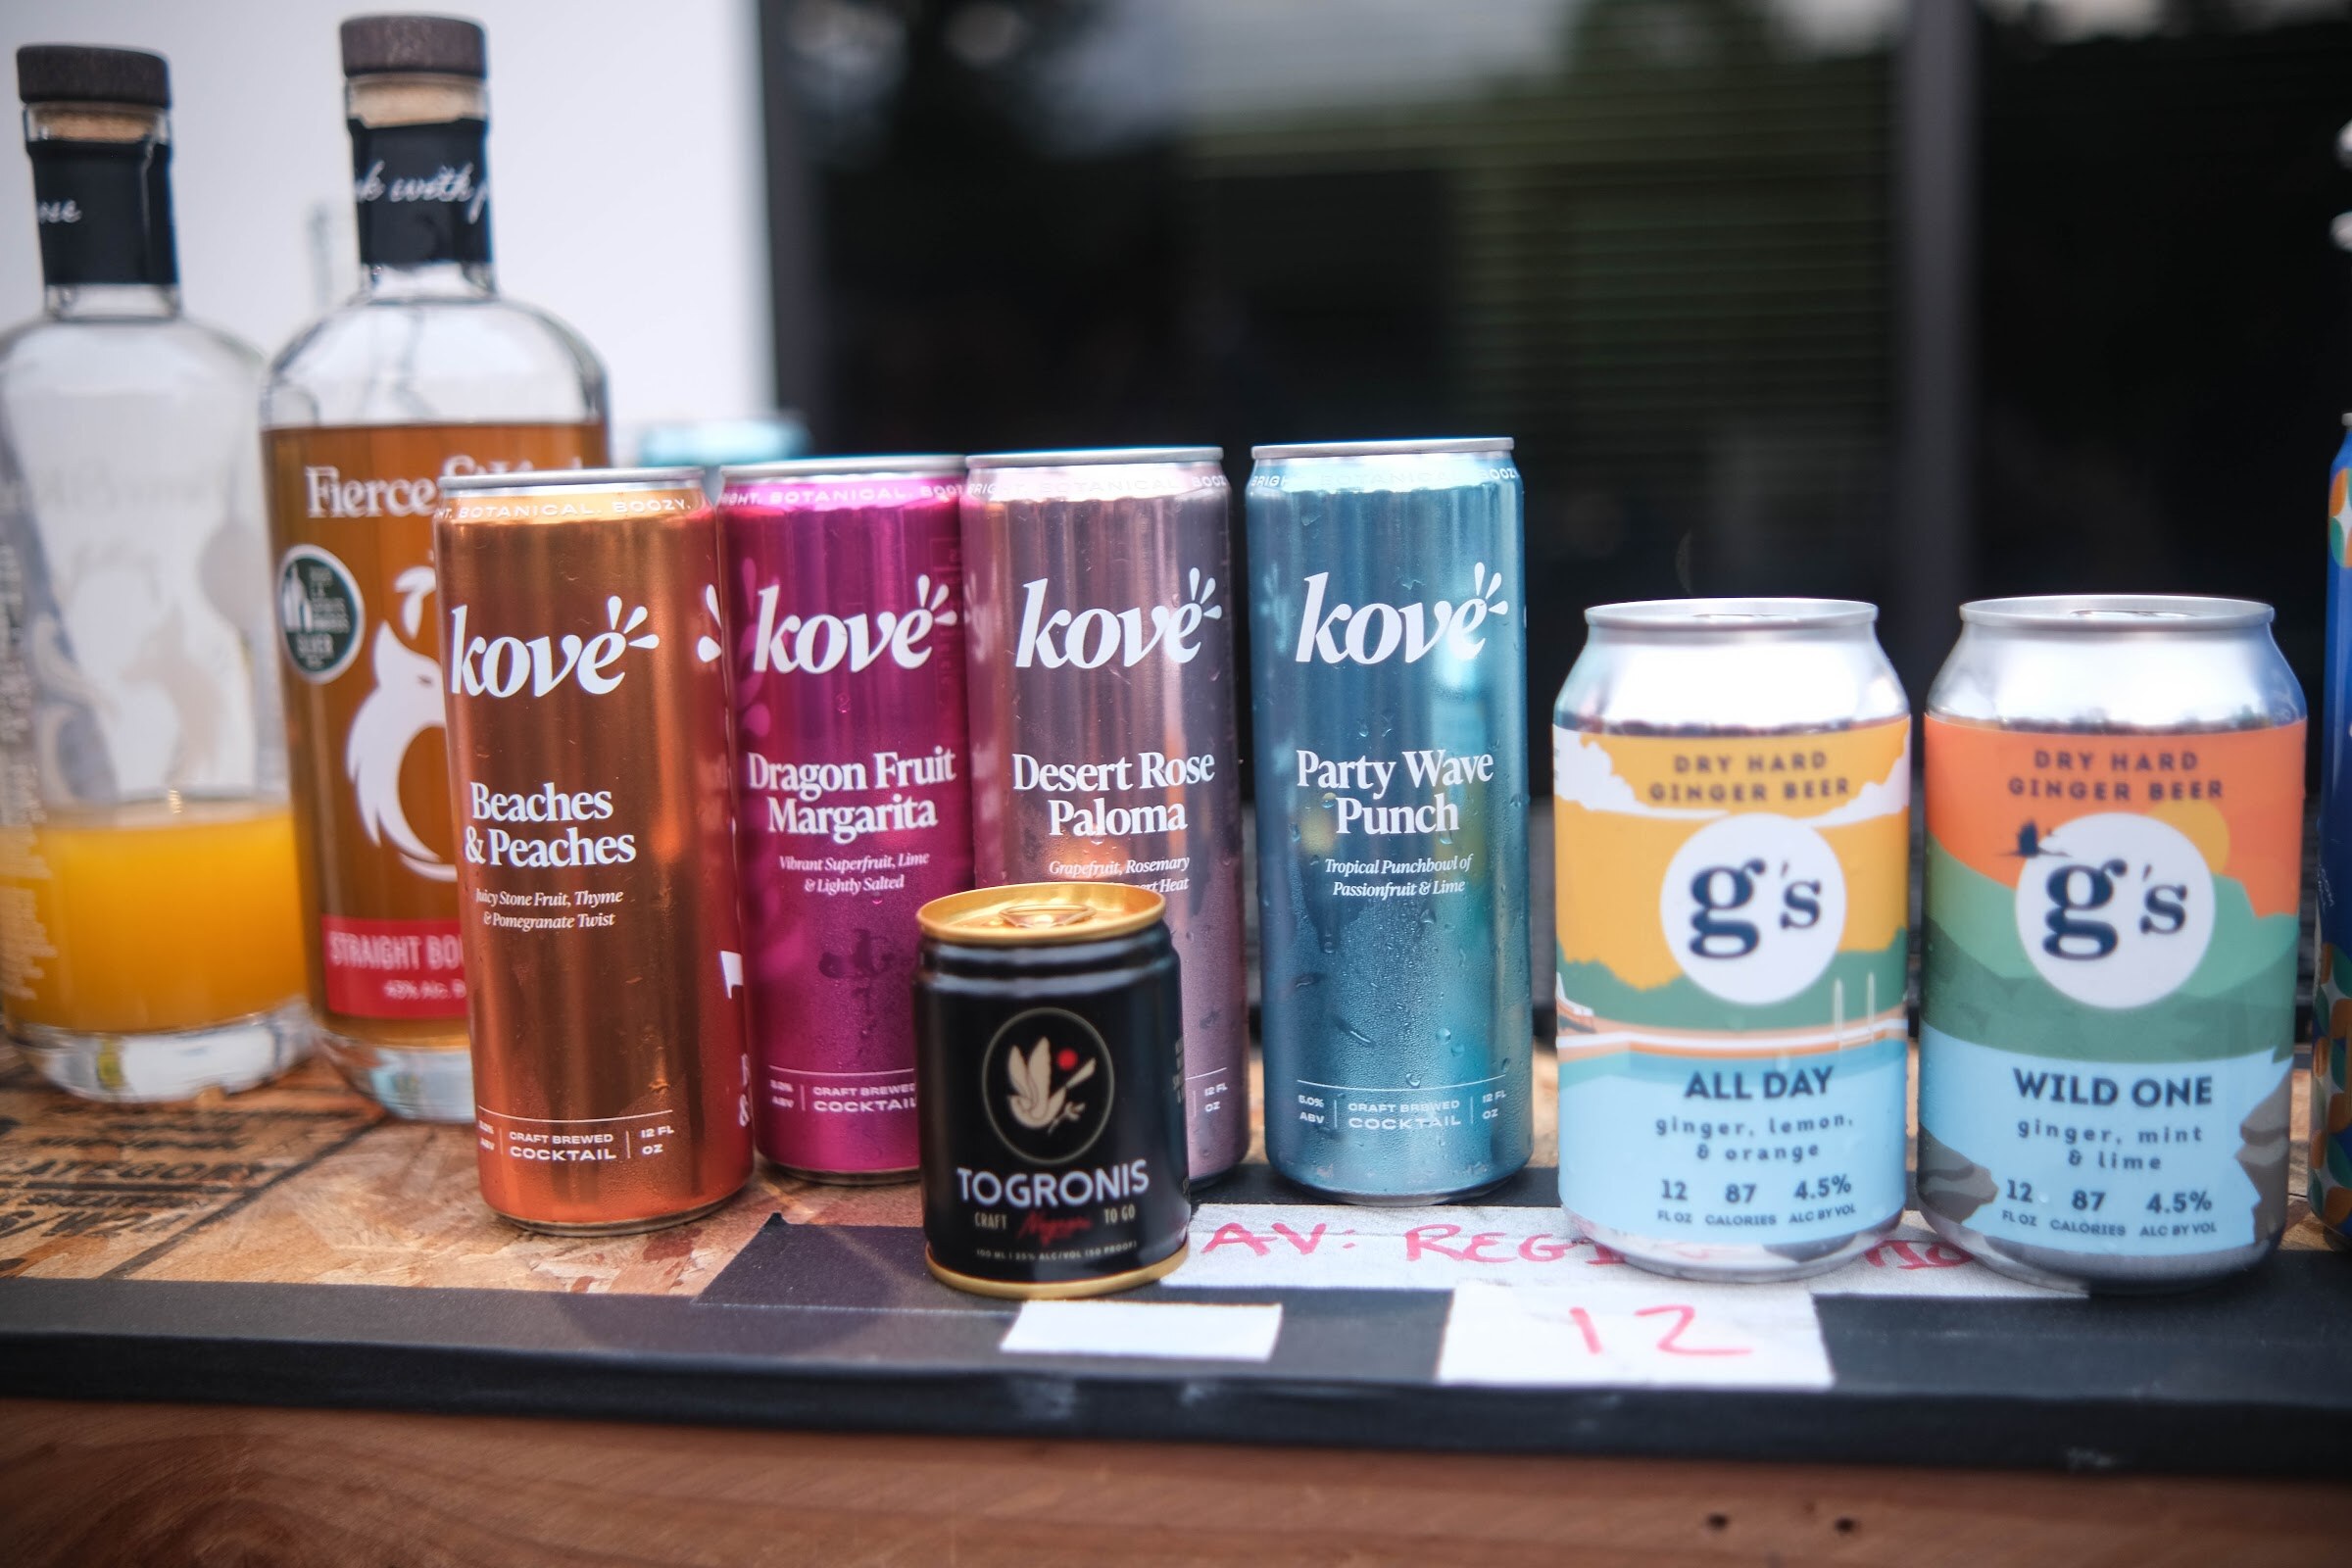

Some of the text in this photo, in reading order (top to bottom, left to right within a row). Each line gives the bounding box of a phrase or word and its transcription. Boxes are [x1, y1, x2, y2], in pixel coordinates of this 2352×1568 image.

[305, 466, 437, 517] Fierce
[458, 503, 602, 519] BOTANICAL.
[612, 498, 692, 514] BOOZY.
[1011, 752, 1215, 792] Desert Rose
[1675, 752, 1828, 773] DRY HARD
[2034, 751, 2199, 772] DRY HARD
[748, 745, 956, 802] Dragon Fruit
[1297, 749, 1494, 800] Party Wave
[1649, 778, 1849, 802] GINGER BEER
[2008, 777, 2224, 802] GINGER BEER
[470, 781, 613, 822] Beaches
[767, 793, 938, 845] Margarita
[1048, 798, 1188, 837] Paloma
[1336, 793, 1460, 835] Punch
[465, 825, 637, 867] & Peaches
[779, 852, 930, 874] Vibrant Superfruit, Lime
[1049, 856, 1191, 878] Grapefruit, Rosemary
[1325, 854, 1474, 877] Tropical Punchbowl of
[805, 875, 905, 896] & Lightly Salted
[1160, 877, 1189, 893] Heat
[1333, 879, 1465, 901] Passionfruit & Lime
[500, 890, 532, 906] Stone
[534, 891, 571, 907] Fruit,
[574, 890, 624, 907] Thyme
[484, 910, 615, 932] & Pomegranate Twist
[328, 931, 422, 970] STRAIGHT
[812, 1086, 858, 1097] CRAFT
[1684, 1065, 1835, 1100] ALL DAY
[2013, 1067, 2213, 1107] WILD ONE
[813, 1098, 916, 1112] COCKTAIL
[1204, 1101, 1220, 1112] OZ
[1348, 1100, 1460, 1114] CRAFT BREWED
[1482, 1090, 1506, 1103] 12 FL
[1299, 1111, 1325, 1124] ABV
[1348, 1114, 1462, 1131] COCKTAIL
[1482, 1107, 1498, 1120] OZ
[509, 1131, 613, 1145] CRAFT BREWED
[641, 1125, 674, 1139] 12 FL
[1655, 1115, 1754, 1139] ginger,
[2018, 1119, 2203, 1145] ginger, mint
[510, 1147, 616, 1161] COCKTAIL
[641, 1144, 663, 1155] OZ
[1696, 1143, 1820, 1163] & orange
[2068, 1149, 2162, 1170] & lime
[956, 1158, 1150, 1208] TOGRONIS
[1661, 1179, 1688, 1200] 12
[1725, 1183, 1757, 1203] 87
[1794, 1174, 1851, 1200] 4.5%
[2007, 1179, 2034, 1203] 12
[2072, 1190, 2106, 1211] 87
[2146, 1190, 2213, 1214] 4.5%
[974, 1211, 1007, 1230] CRAFT
[1103, 1206, 1118, 1224] TO
[1120, 1203, 1136, 1222] GO
[1657, 1210, 1693, 1224] FL OZ
[1705, 1214, 1777, 1226] CALORIES
[1788, 1203, 1856, 1225] ALC BY VOL
[2001, 1209, 2037, 1227] FL OZ
[1201, 1222, 1356, 1256] AV:
[2050, 1219, 2126, 1237] CALORIES
[2139, 1221, 2217, 1237] ALC BY VOL
[1568, 1304, 1754, 1356] 12
